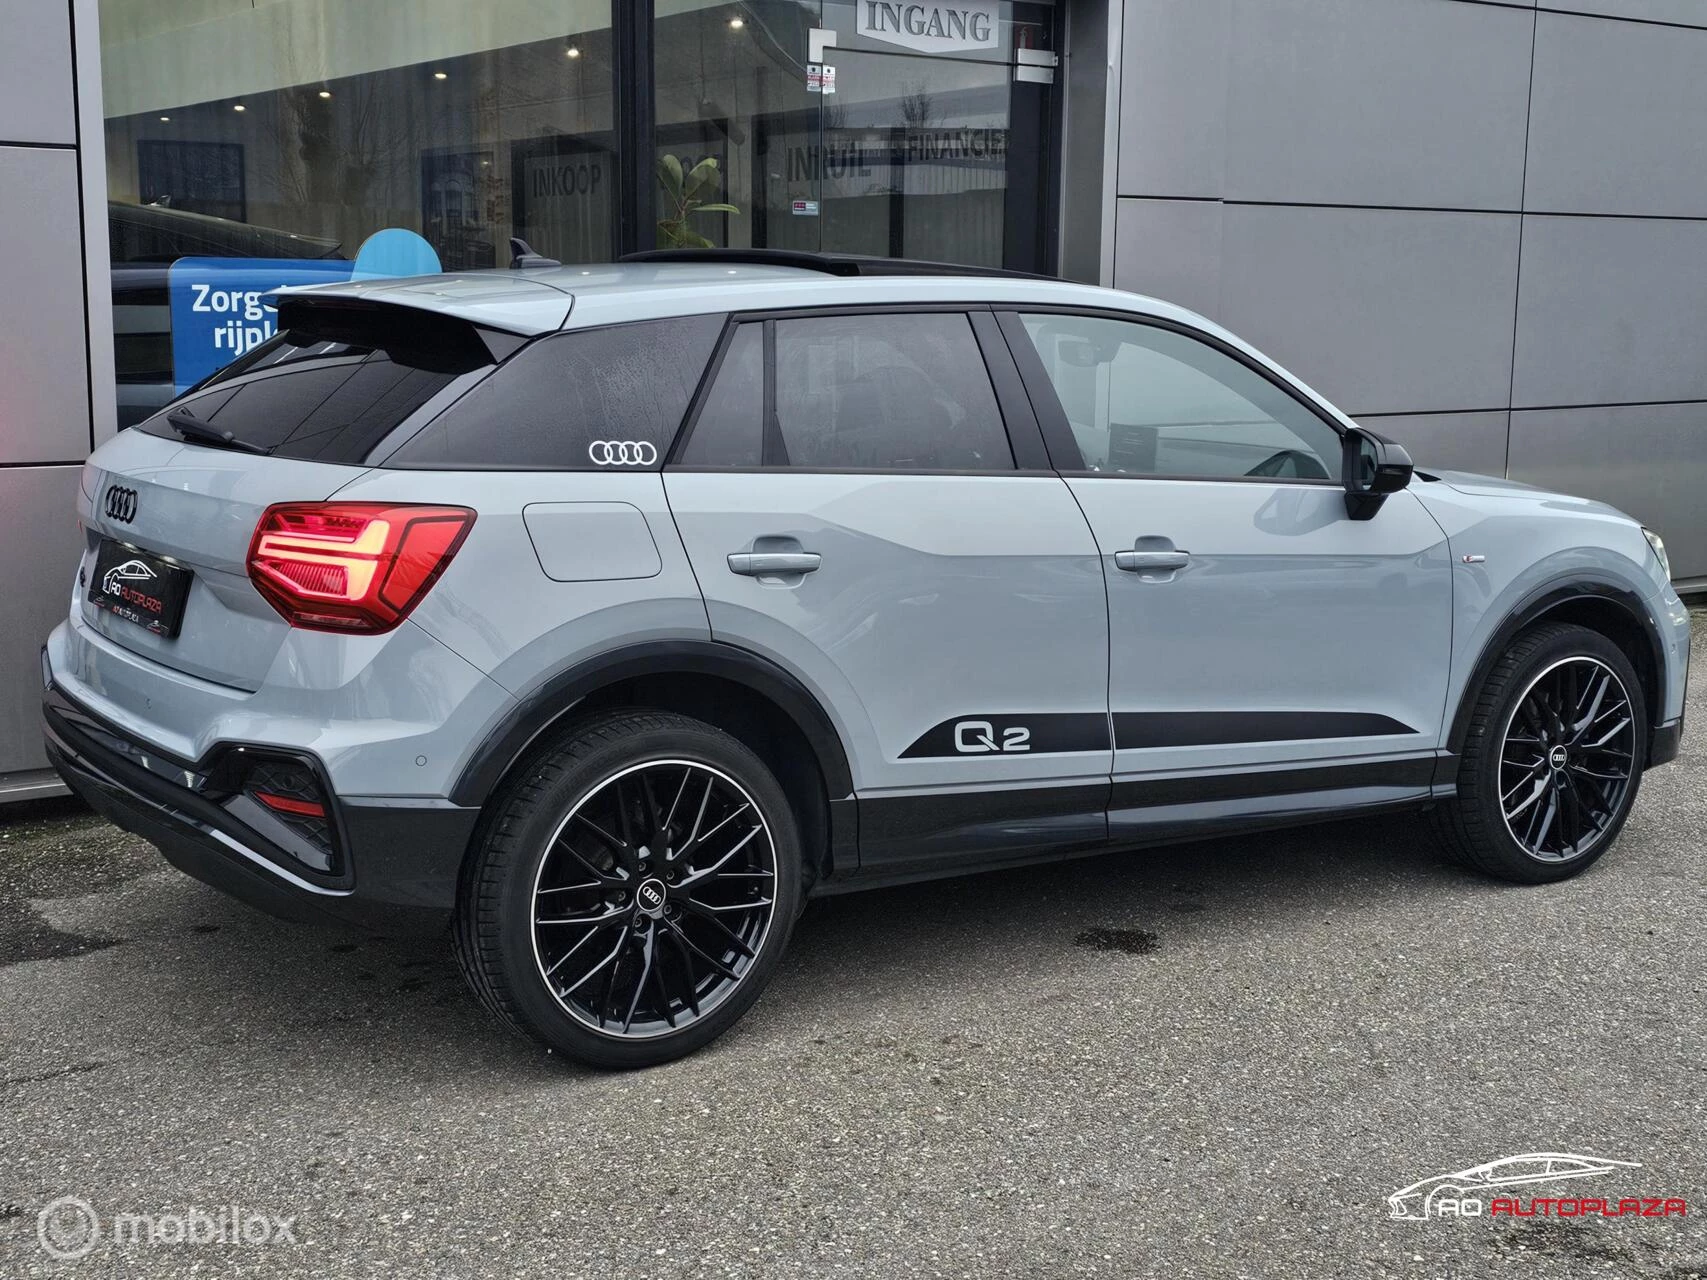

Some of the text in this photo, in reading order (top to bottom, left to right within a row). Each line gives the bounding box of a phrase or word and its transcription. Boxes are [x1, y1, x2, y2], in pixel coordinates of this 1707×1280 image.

[865, 0, 991, 42] INGANG
[533, 164, 601, 197] INKOOP
[192, 284, 279, 321] Zorg
[215, 320, 279, 355] rijpl
[121, 586, 162, 614] AUTOPLAZA
[955, 720, 1031, 752] Q2
